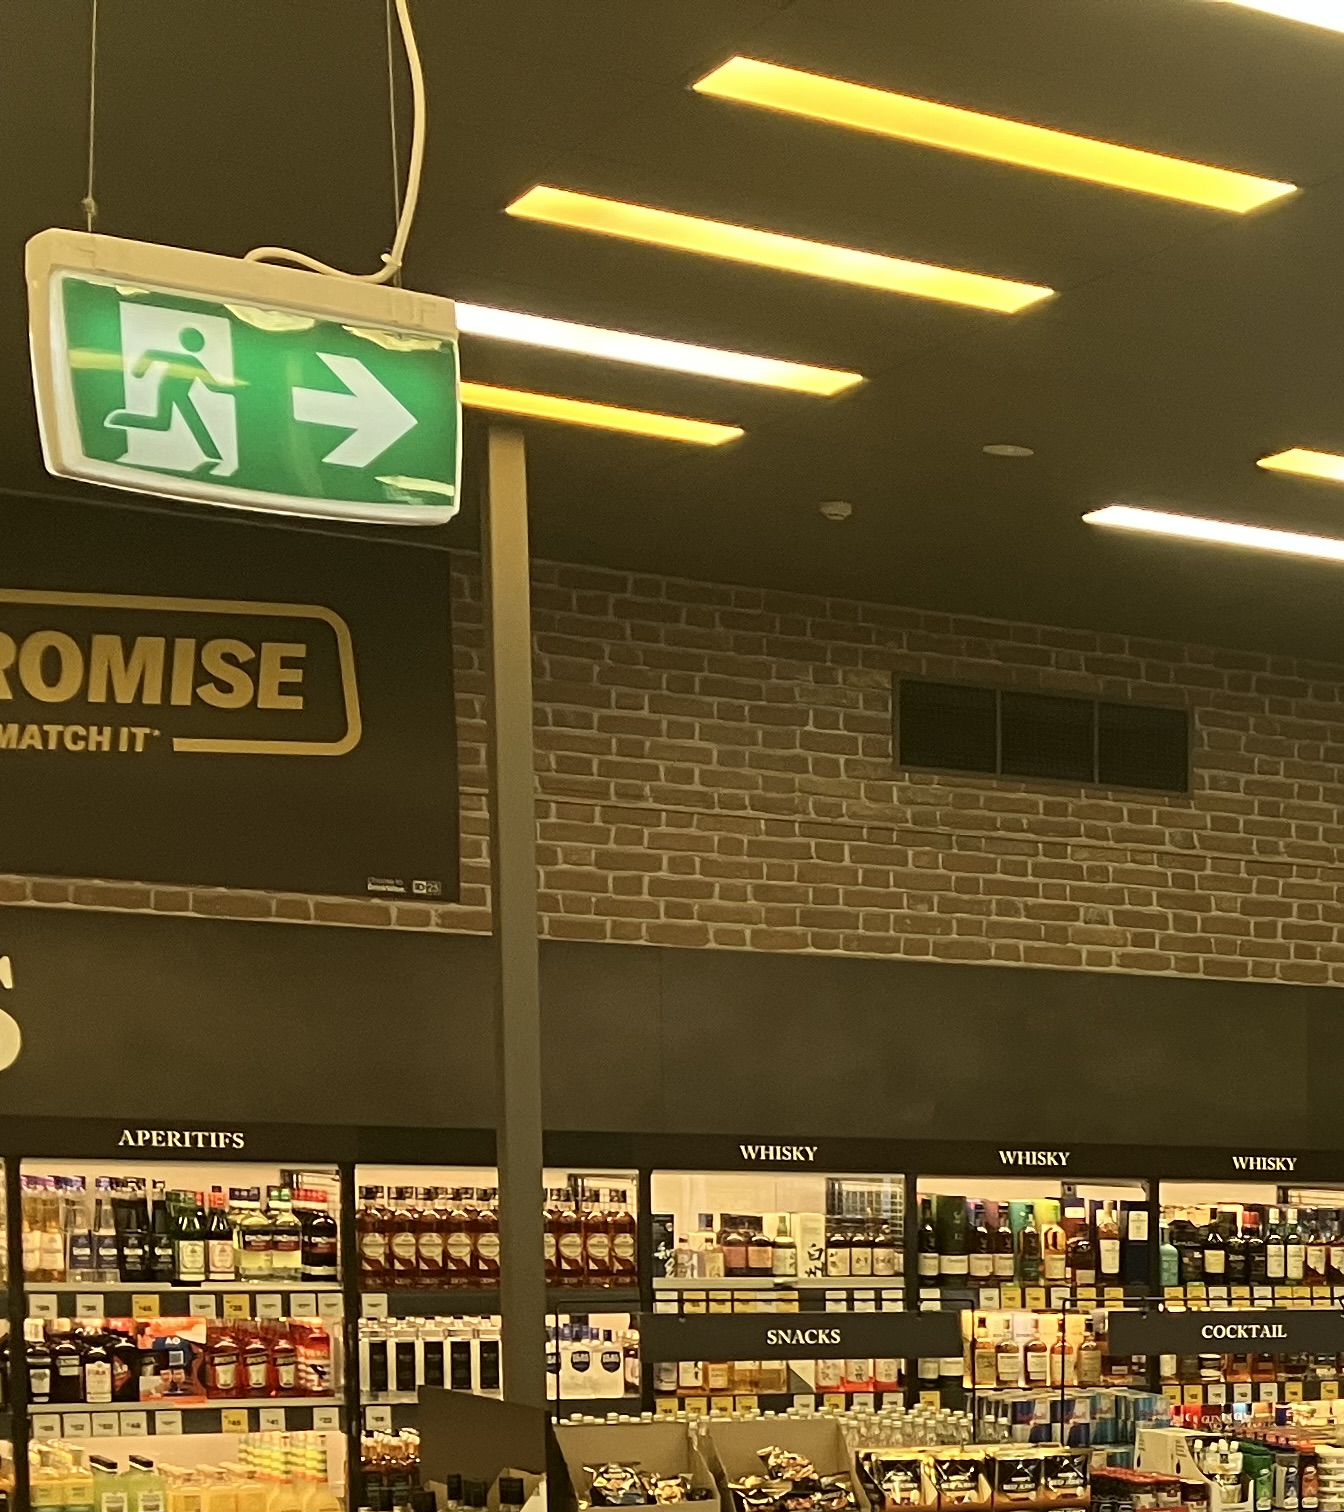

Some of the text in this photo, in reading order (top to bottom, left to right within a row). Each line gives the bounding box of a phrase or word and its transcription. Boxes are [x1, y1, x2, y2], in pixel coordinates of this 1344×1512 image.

[0, 629, 306, 711] OMISE
[118, 1129, 245, 1150] APERITIFS
[739, 1144, 818, 1162] WHISKY
[998, 1150, 1070, 1167] WHISKY
[1232, 1156, 1297, 1173] WHISKY
[766, 1328, 841, 1345] SNACKS
[1201, 1323, 1287, 1341] COCKTAIL
